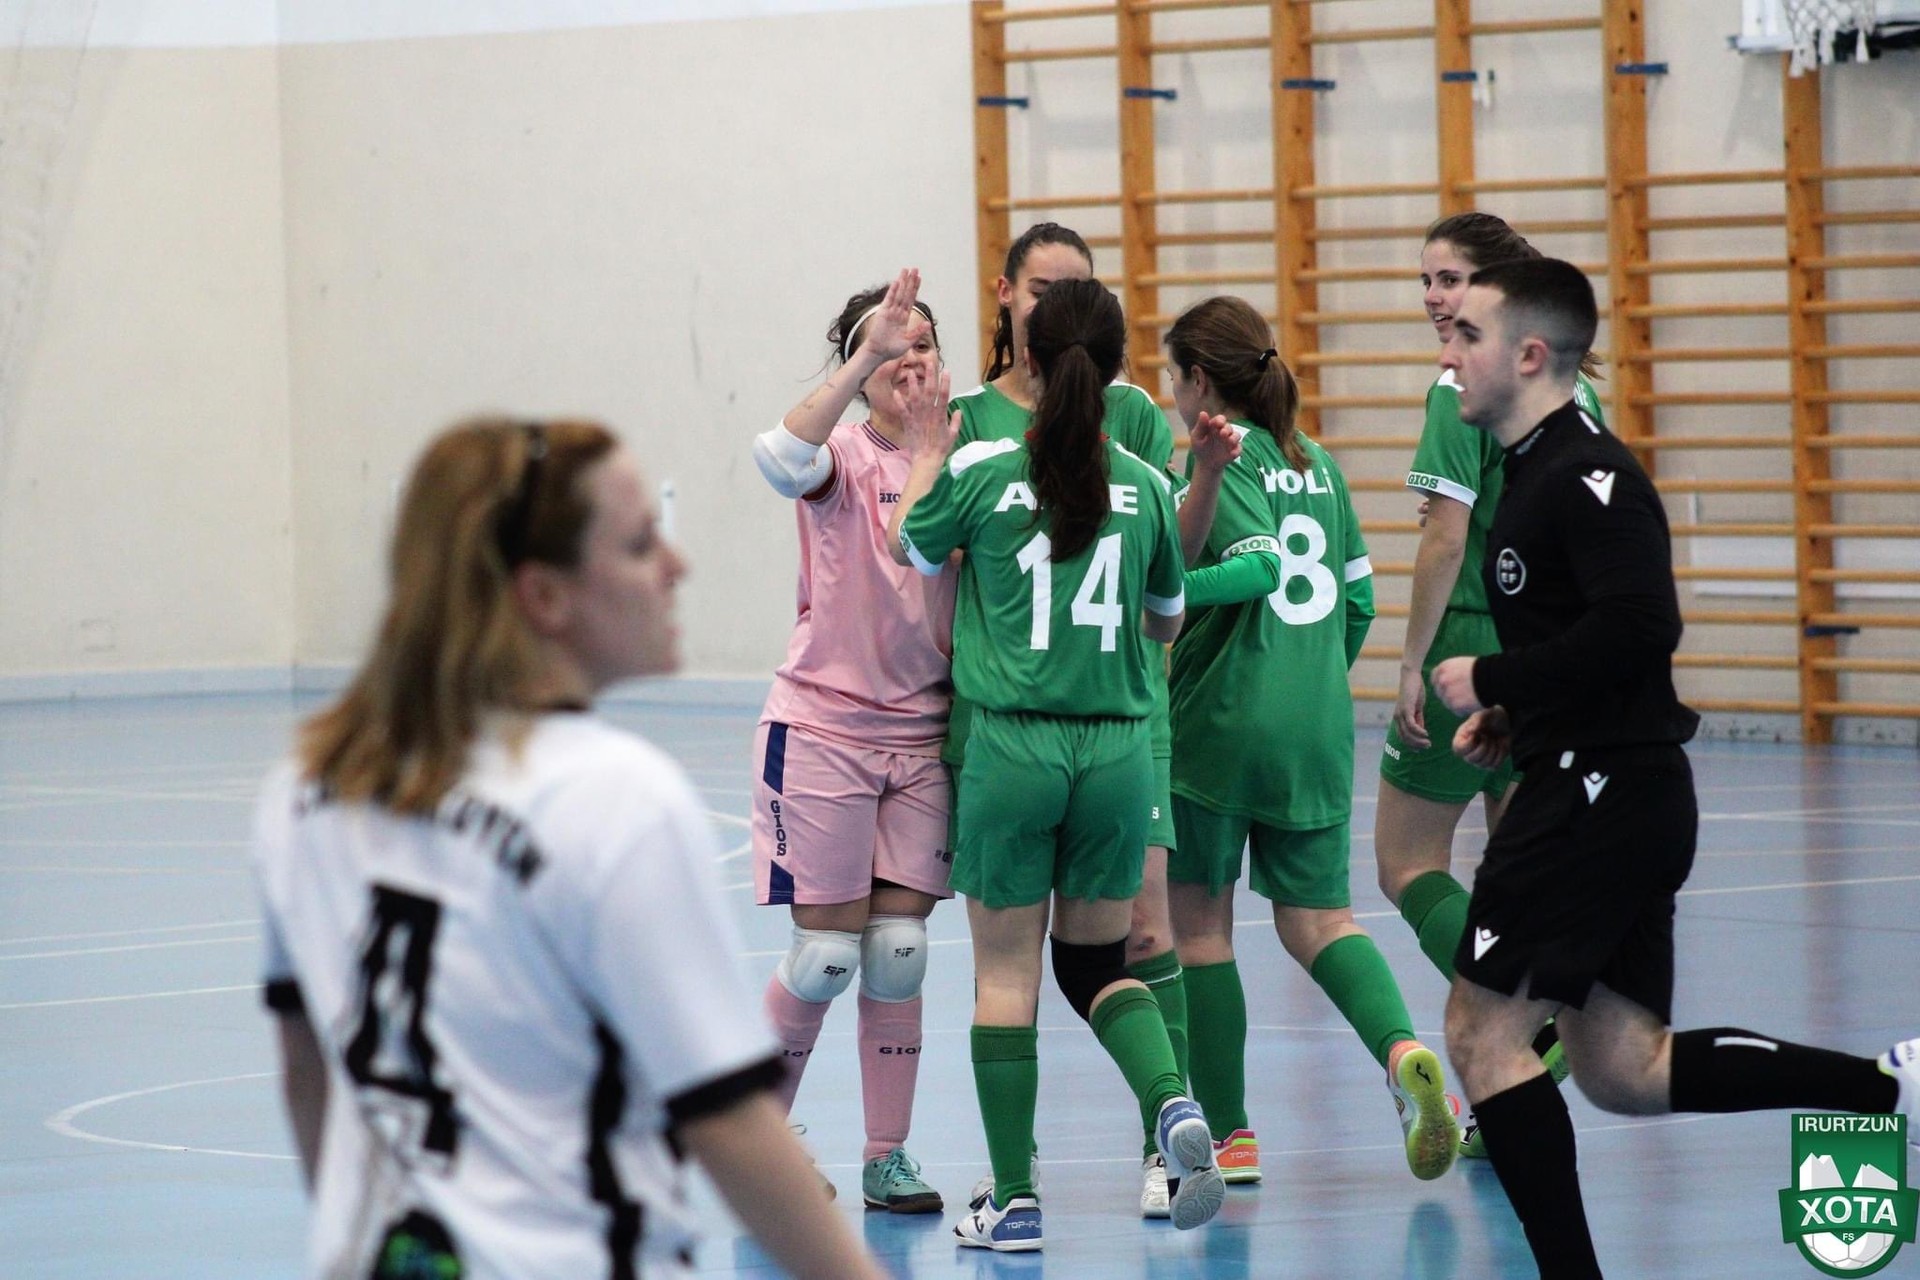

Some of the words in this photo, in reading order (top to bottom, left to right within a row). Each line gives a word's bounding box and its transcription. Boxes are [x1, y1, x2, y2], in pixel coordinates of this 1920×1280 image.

[1408, 474, 1438, 489] GIOS
[1016, 530, 1123, 652] 14
[1267, 513, 1338, 625] 8
[770, 800, 787, 856] GIOS
